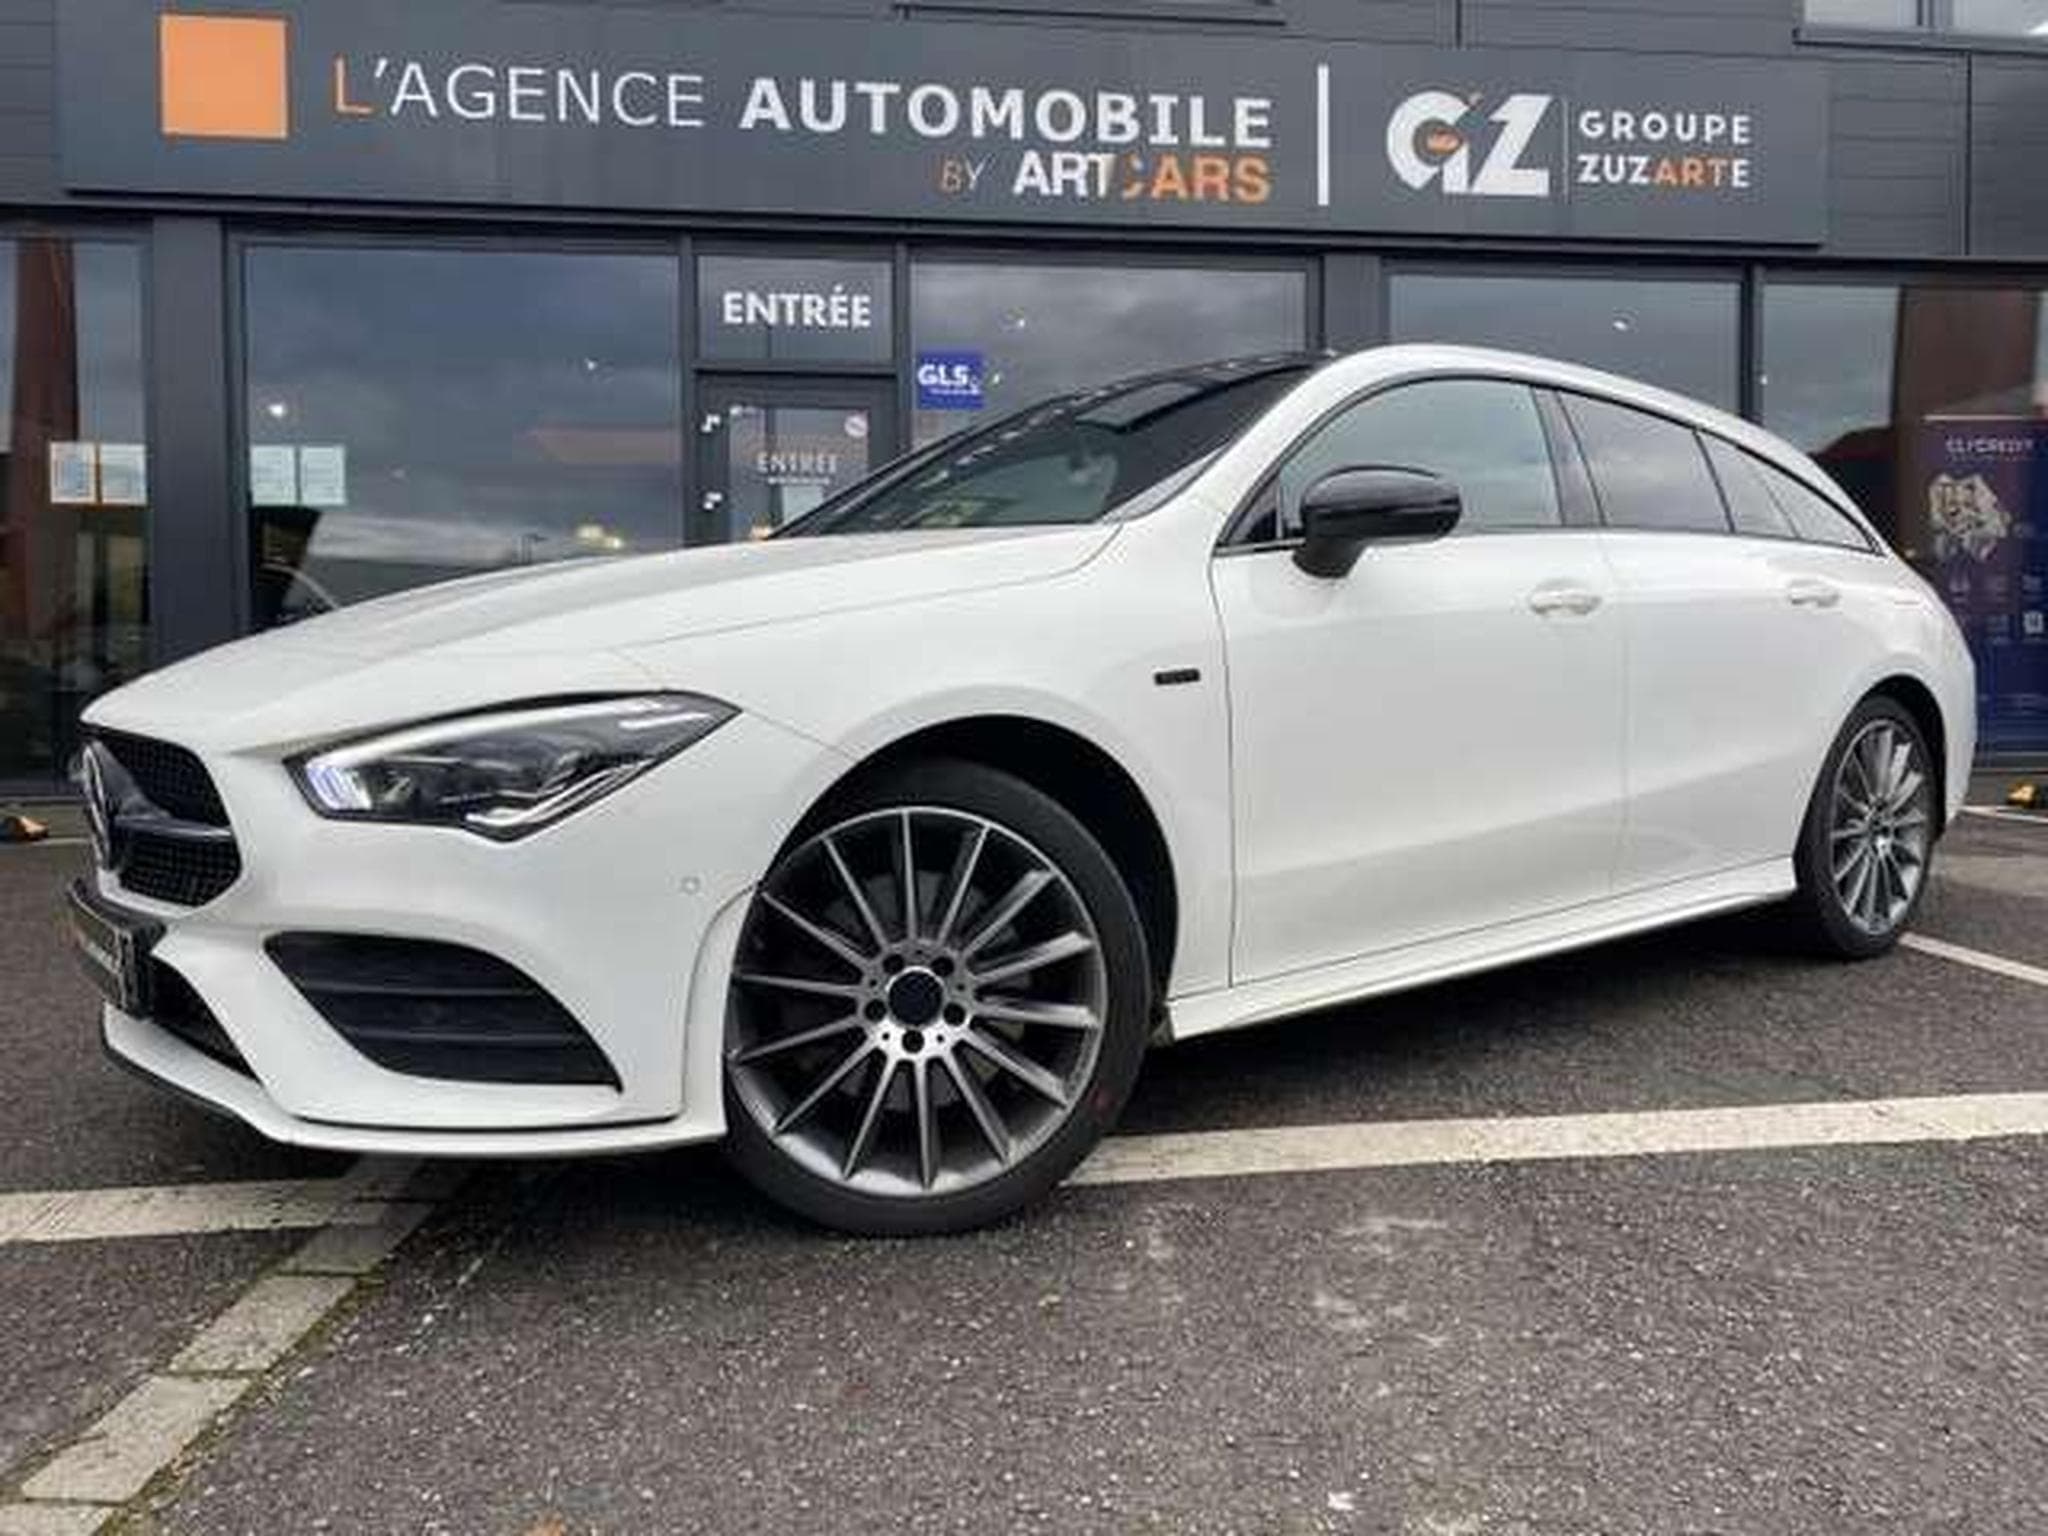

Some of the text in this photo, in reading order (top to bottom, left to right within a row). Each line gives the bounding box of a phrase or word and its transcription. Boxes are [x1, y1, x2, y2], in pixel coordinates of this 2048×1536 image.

[335, 57, 1273, 149] L'AGENCE AUTOMOBILE
[1579, 110, 1751, 146] GROUPE
[941, 158, 987, 193] BY
[1577, 153, 1751, 189] ZUZARTE
[722, 285, 872, 328] ENTRÉE
